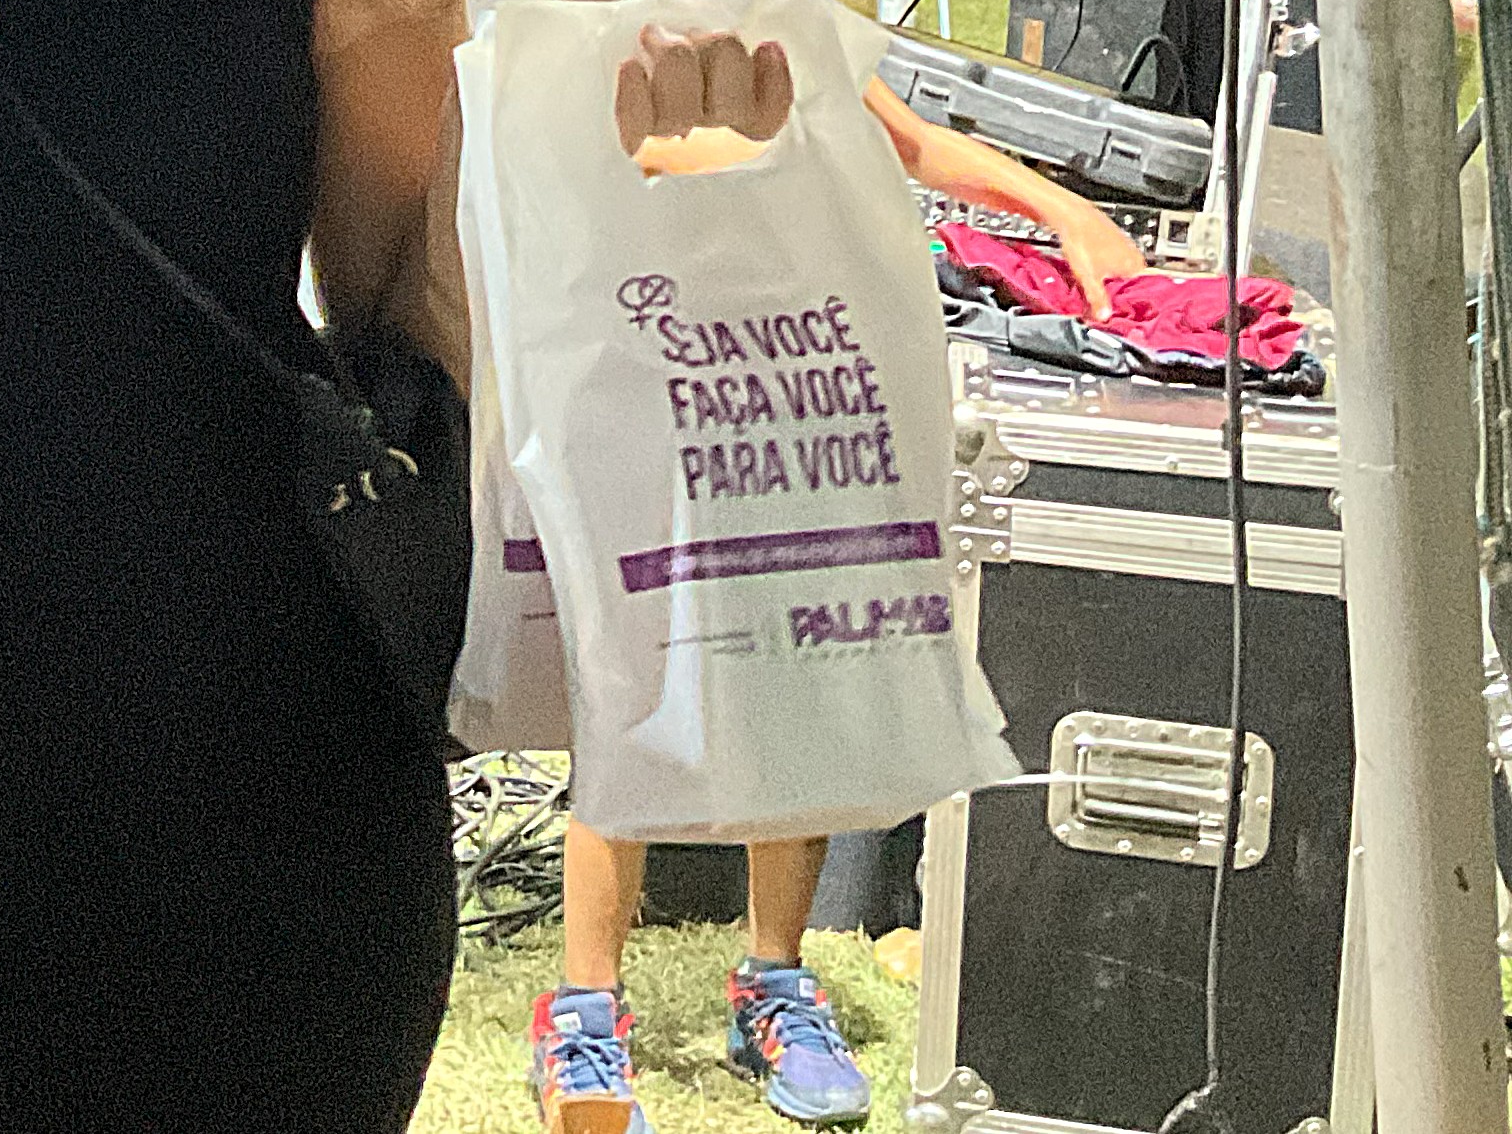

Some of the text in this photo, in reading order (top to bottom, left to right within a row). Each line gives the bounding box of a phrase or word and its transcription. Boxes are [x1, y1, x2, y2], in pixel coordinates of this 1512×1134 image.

[656, 296, 861, 368] SEJA VOCÊ
[667, 357, 887, 435] FAÇA VOCÊ
[680, 422, 900, 500] PARA VOCÊ
